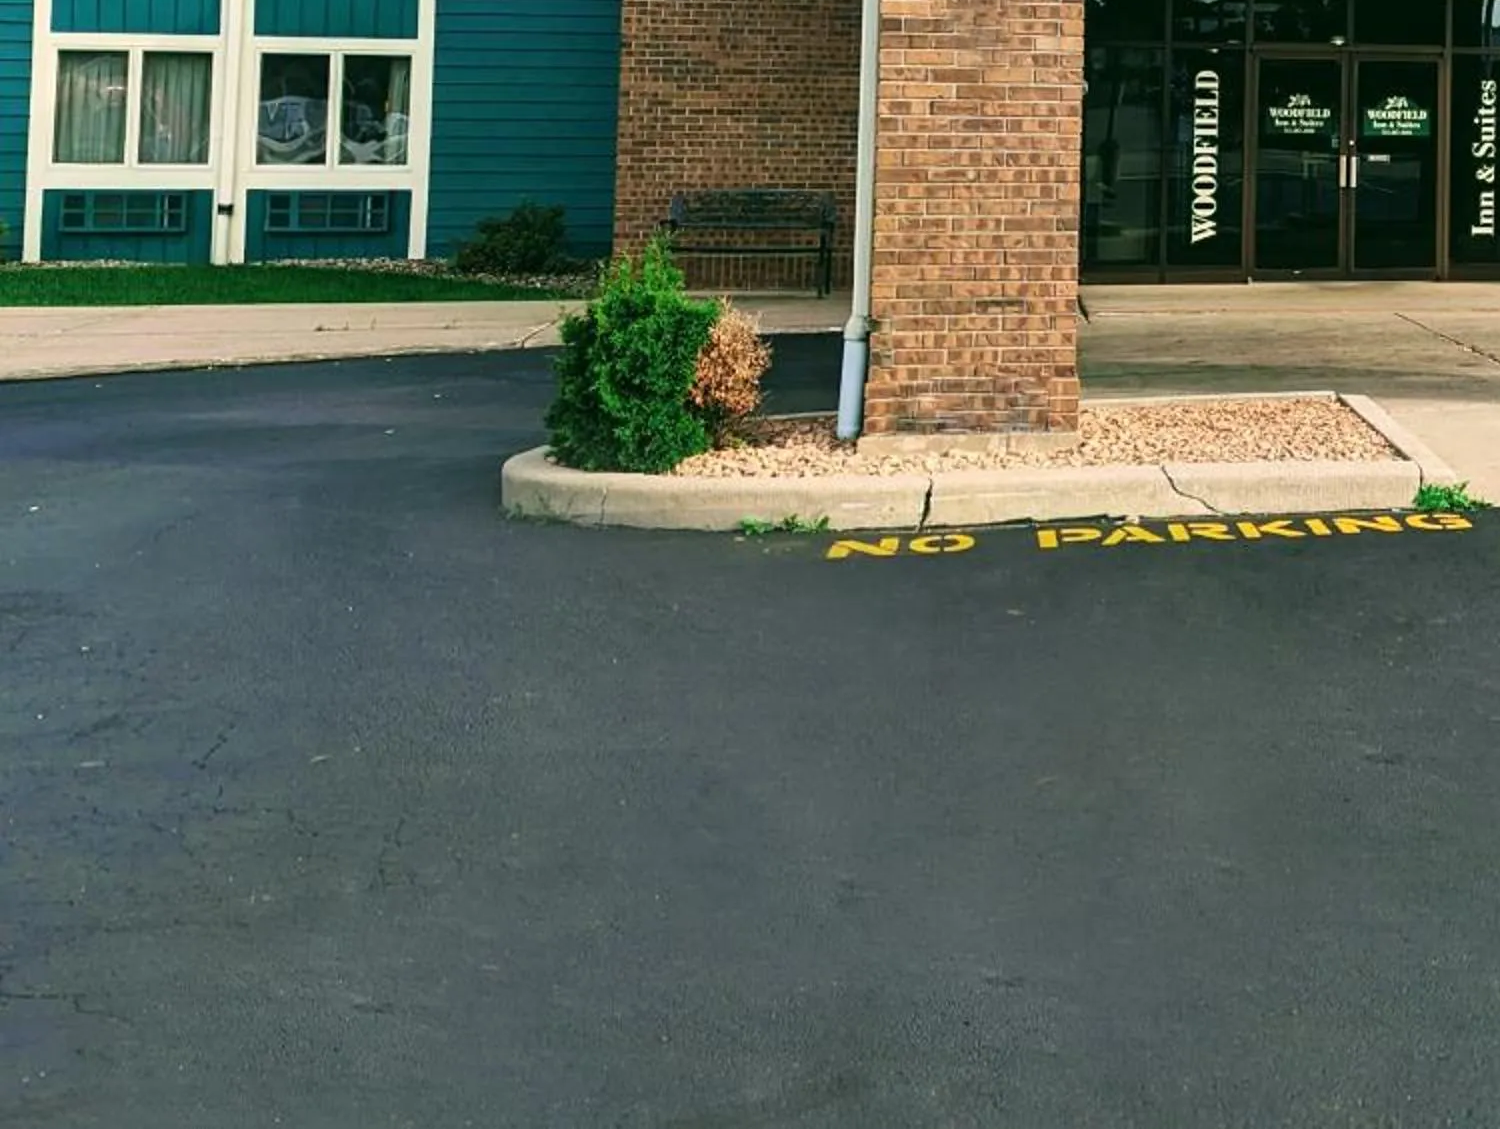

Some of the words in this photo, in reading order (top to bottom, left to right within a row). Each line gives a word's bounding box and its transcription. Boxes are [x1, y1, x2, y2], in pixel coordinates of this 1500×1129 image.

[1471, 79, 1497, 158] Suites
[1191, 70, 1219, 244] WOODFIELD
[1475, 164, 1495, 183] &
[1471, 191, 1495, 237] Inn
[826, 534, 975, 559] NO
[1037, 514, 1473, 549] PARKING
